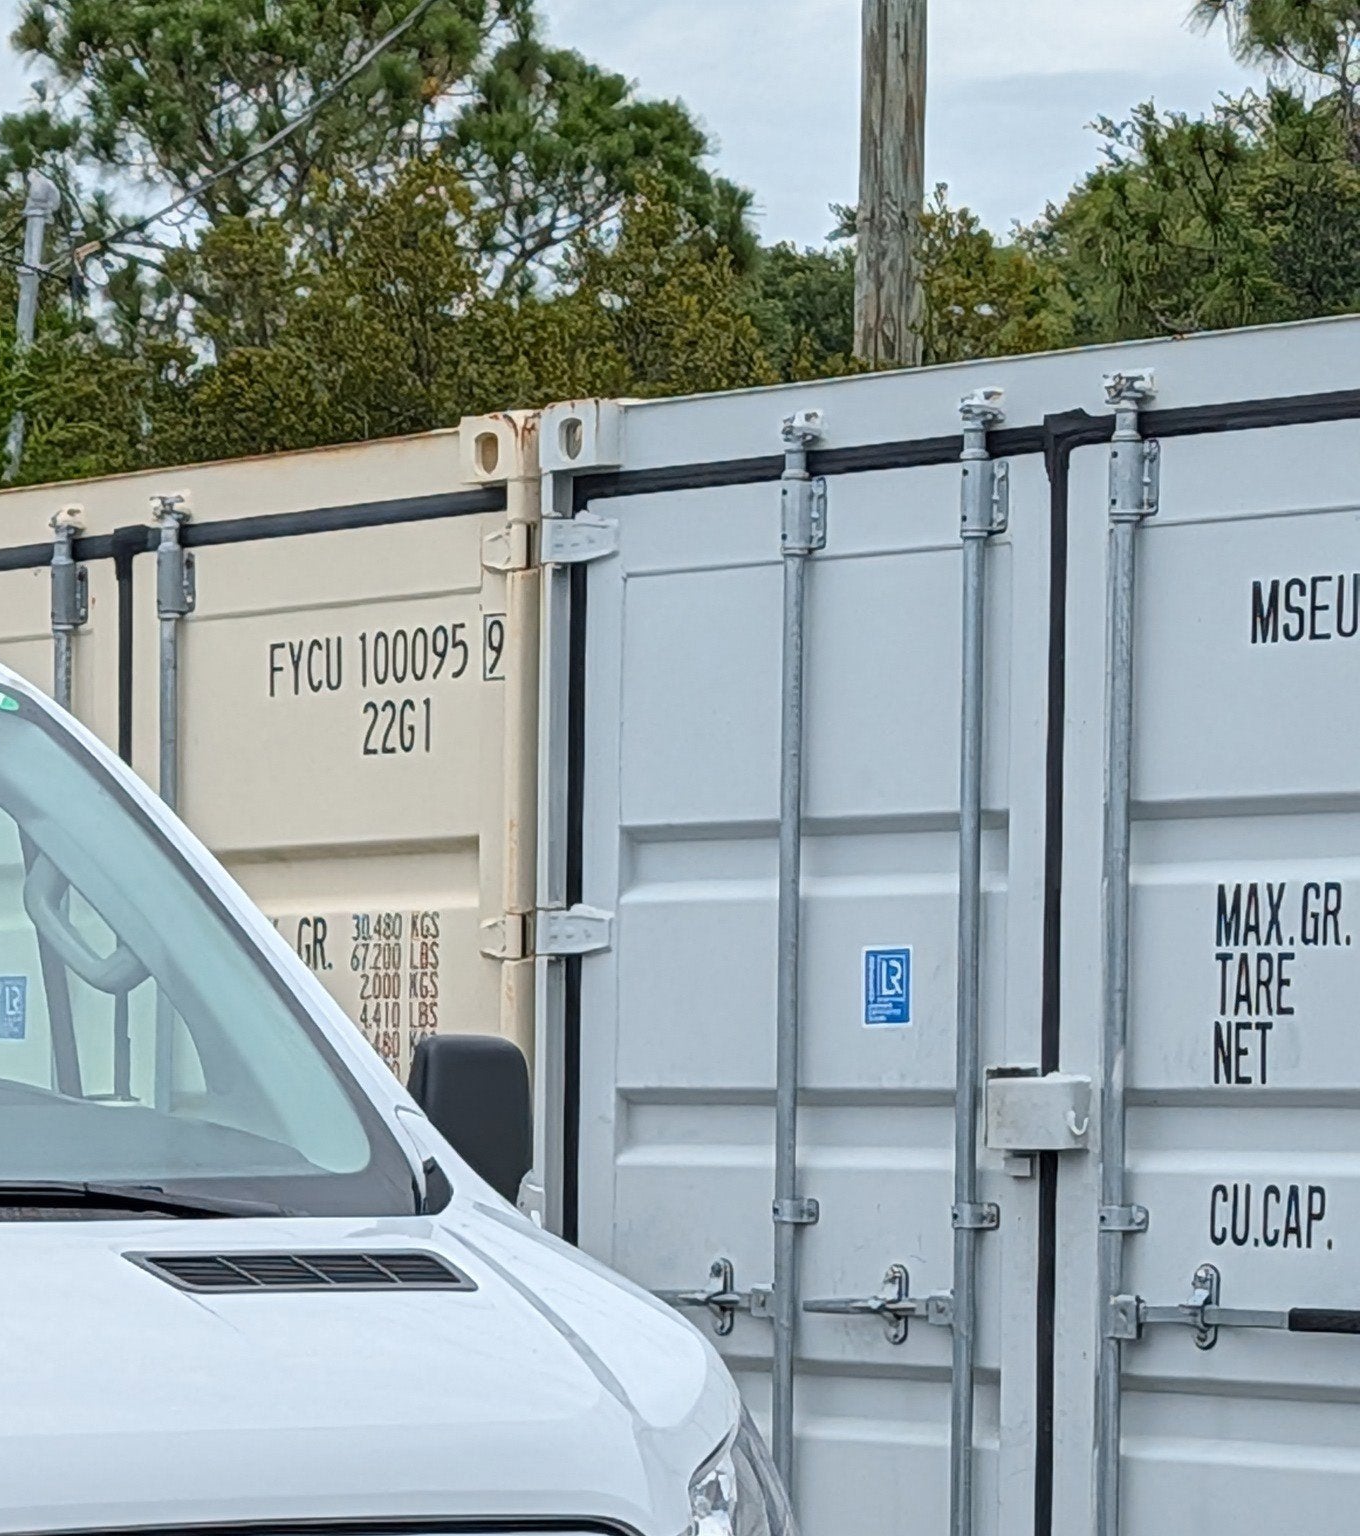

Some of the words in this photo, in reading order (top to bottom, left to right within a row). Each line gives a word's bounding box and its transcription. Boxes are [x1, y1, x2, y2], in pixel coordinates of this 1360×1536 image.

[1250, 573, 1360, 644] MSEU
[269, 636, 342, 698] FYCU
[358, 622, 469, 688] 100095
[487, 619, 505, 675] 9
[362, 697, 431, 756] 22G1
[297, 916, 334, 971] GR.
[410, 910, 440, 941] KGS
[409, 941, 440, 970] LBS
[409, 971, 439, 999] KGS
[409, 1001, 439, 1028] LBS
[1215, 952, 1295, 1016] TARE
[1213, 1020, 1273, 1085] NET
[1210, 1183, 1333, 1250] CU.CAP.
